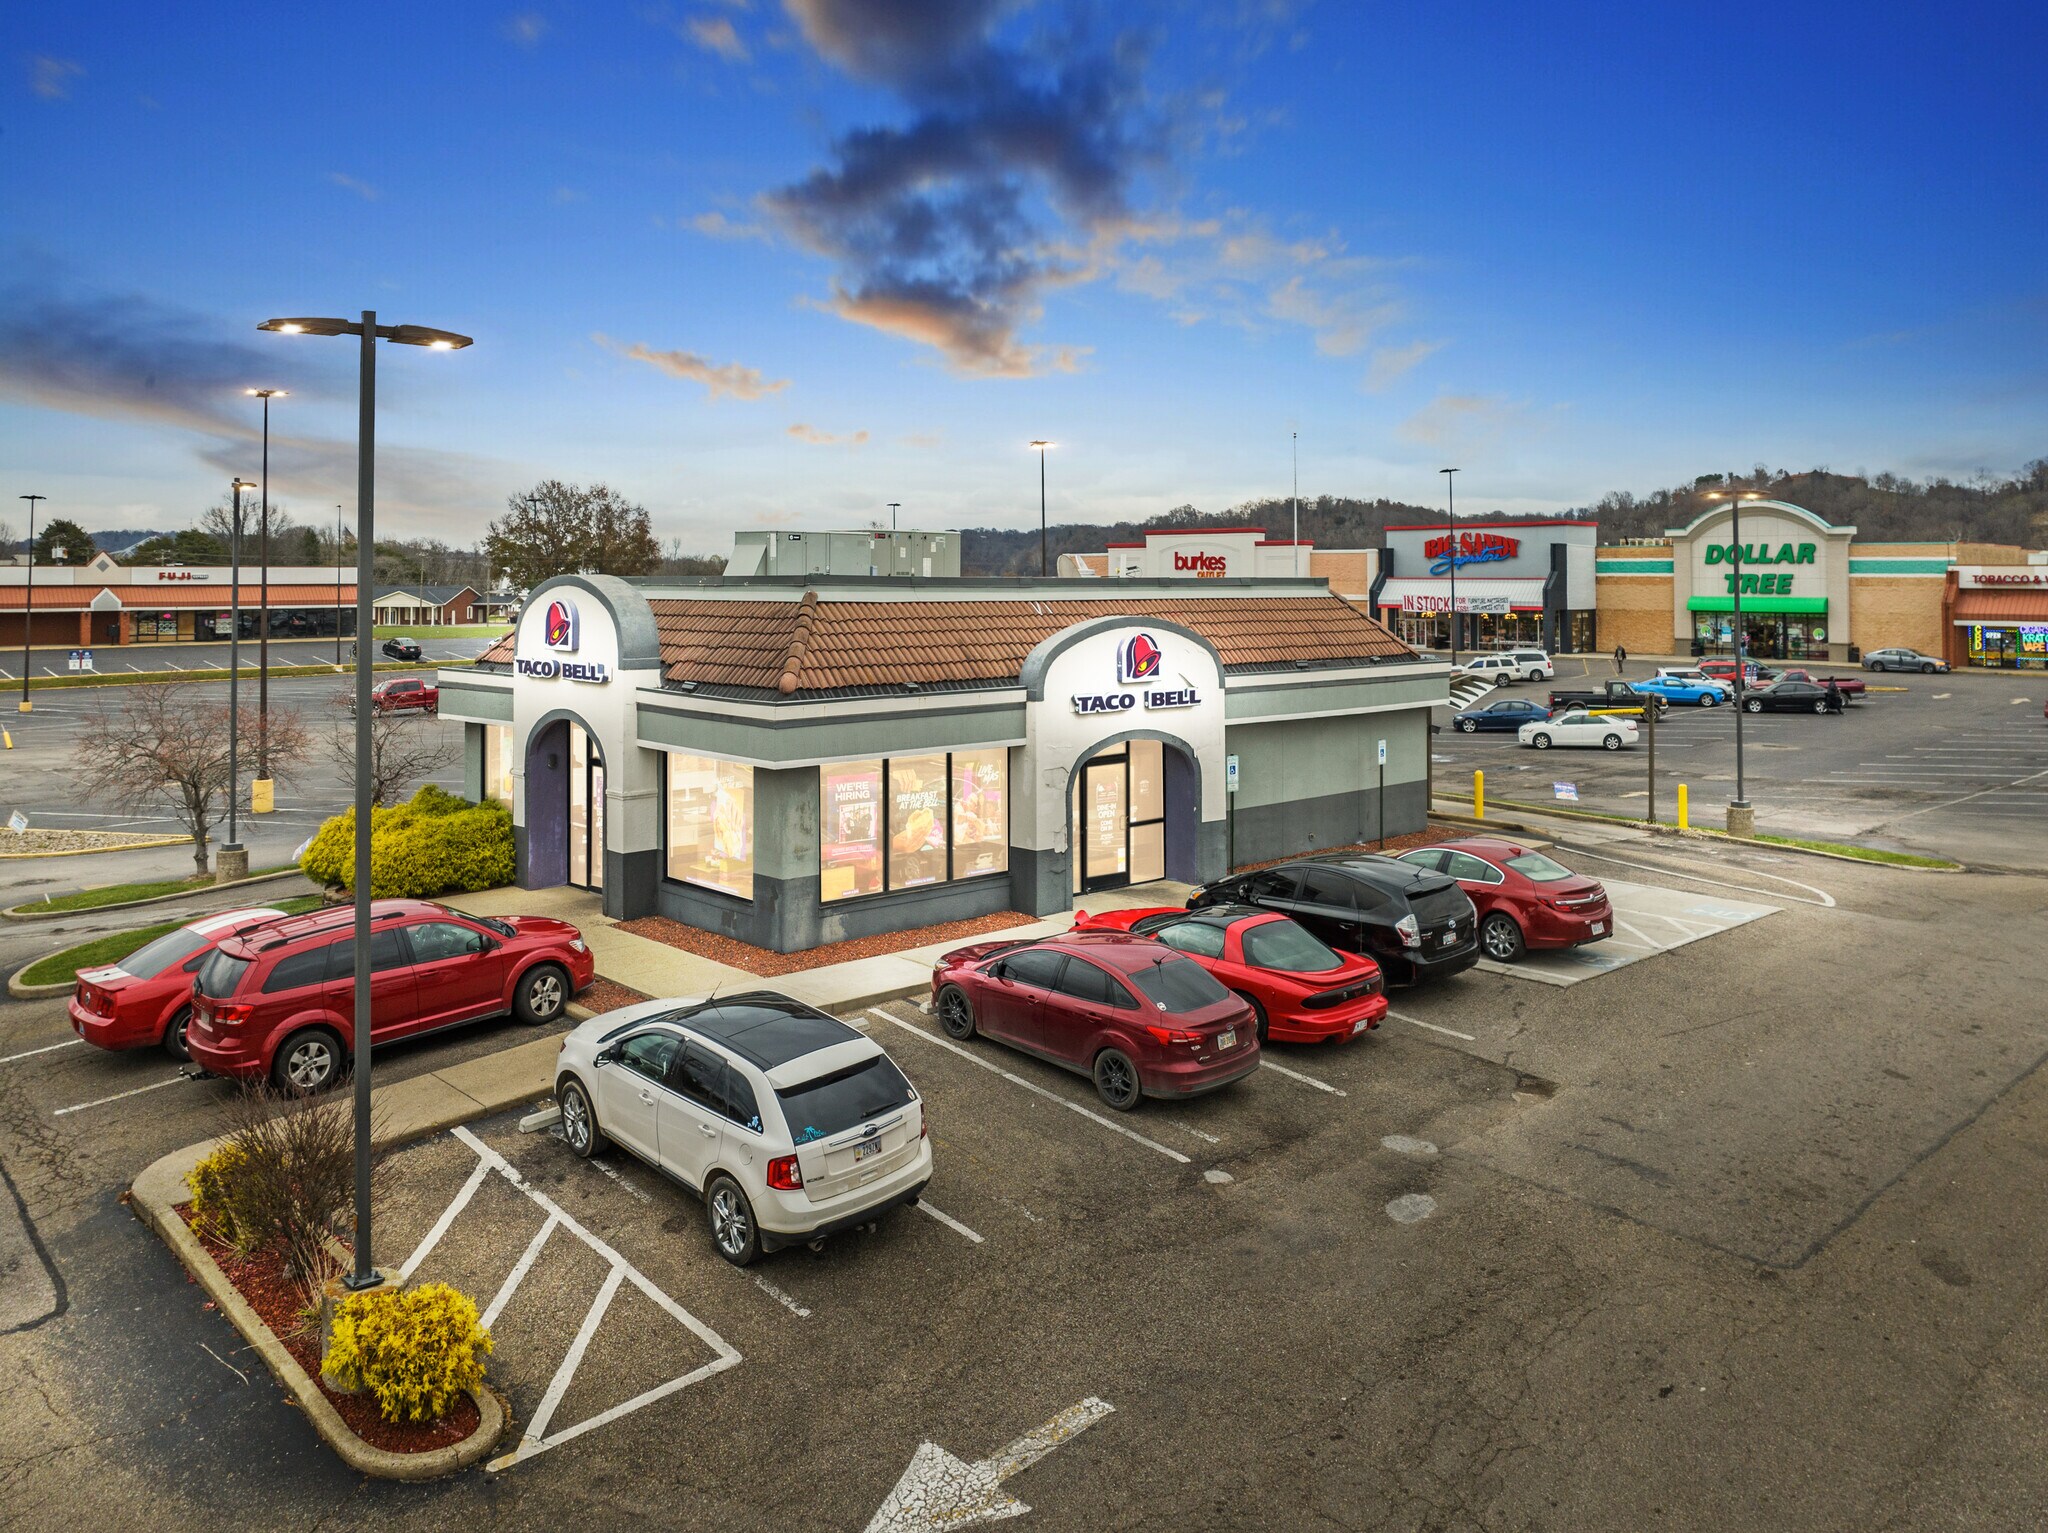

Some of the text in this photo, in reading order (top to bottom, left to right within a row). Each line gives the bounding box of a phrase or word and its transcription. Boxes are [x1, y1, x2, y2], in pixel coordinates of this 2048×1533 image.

[1460, 532, 1520, 557] SANDY
[1174, 551, 1227, 571] burkes
[1429, 546, 1511, 576] Superstore
[1704, 543, 1817, 565] DOLLAR
[159, 572, 191, 581] FUJI
[1724, 573, 1794, 595] TREE
[1973, 575, 2030, 584] TOBACCO
[2033, 575, 2042, 585] &
[1403, 595, 1452, 612] IN STOCK
[1974, 625, 1982, 650] CBD
[1985, 631, 2001, 639] OPEN
[2023, 642, 2046, 652] VAPE
[516, 659, 601, 682] TACO BELL
[1077, 690, 1202, 713] TACO BELL
[836, 781, 869, 793] WE'RE
[835, 789, 871, 802] HIRING
[896, 791, 938, 803] BREAKFAST
[899, 801, 909, 810] AT
[909, 801, 922, 809] THE
[1097, 810, 1116, 819] OPEN
